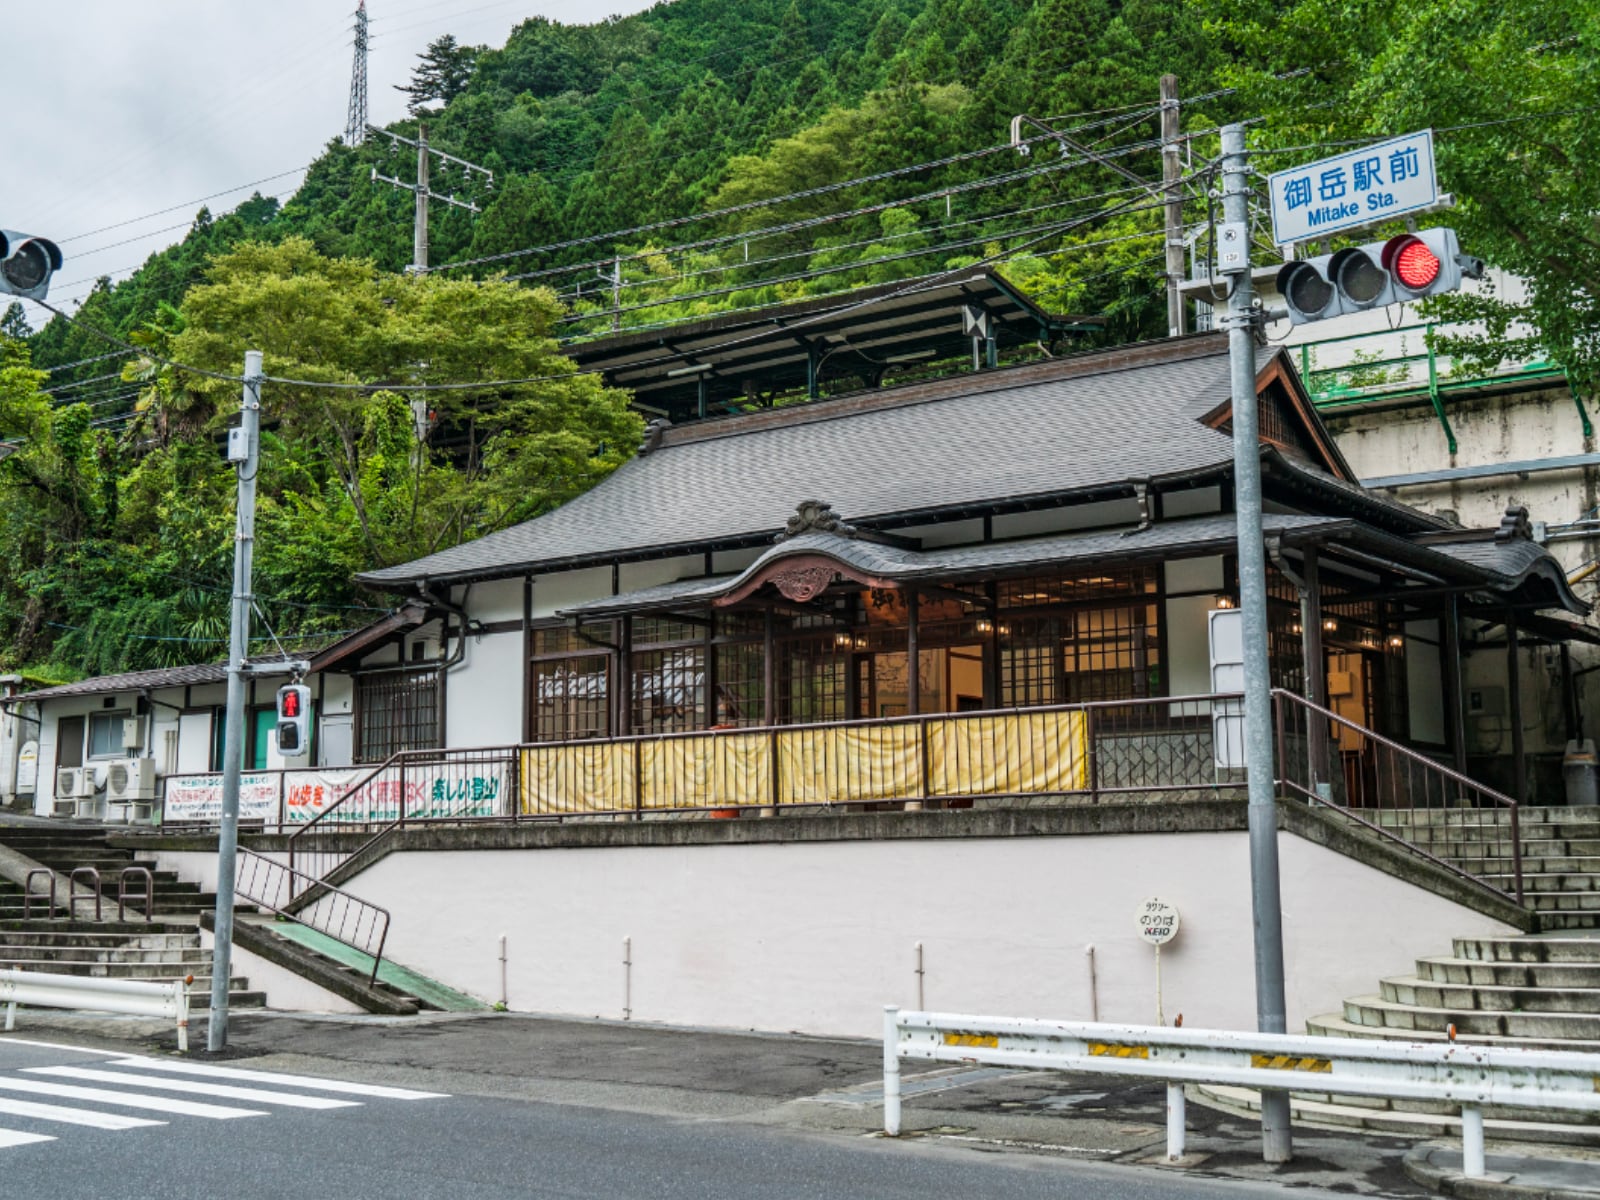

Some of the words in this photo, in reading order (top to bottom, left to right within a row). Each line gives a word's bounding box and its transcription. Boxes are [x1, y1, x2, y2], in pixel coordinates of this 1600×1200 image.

[1284, 146, 1419, 211] 御岳駅前
[1308, 203, 1359, 226] Mitake
[1367, 193, 1398, 211] Sta.
[288, 784, 324, 806] 山歩き
[432, 775, 499, 801] 楽しい登山
[1140, 915, 1174, 926] のりば
